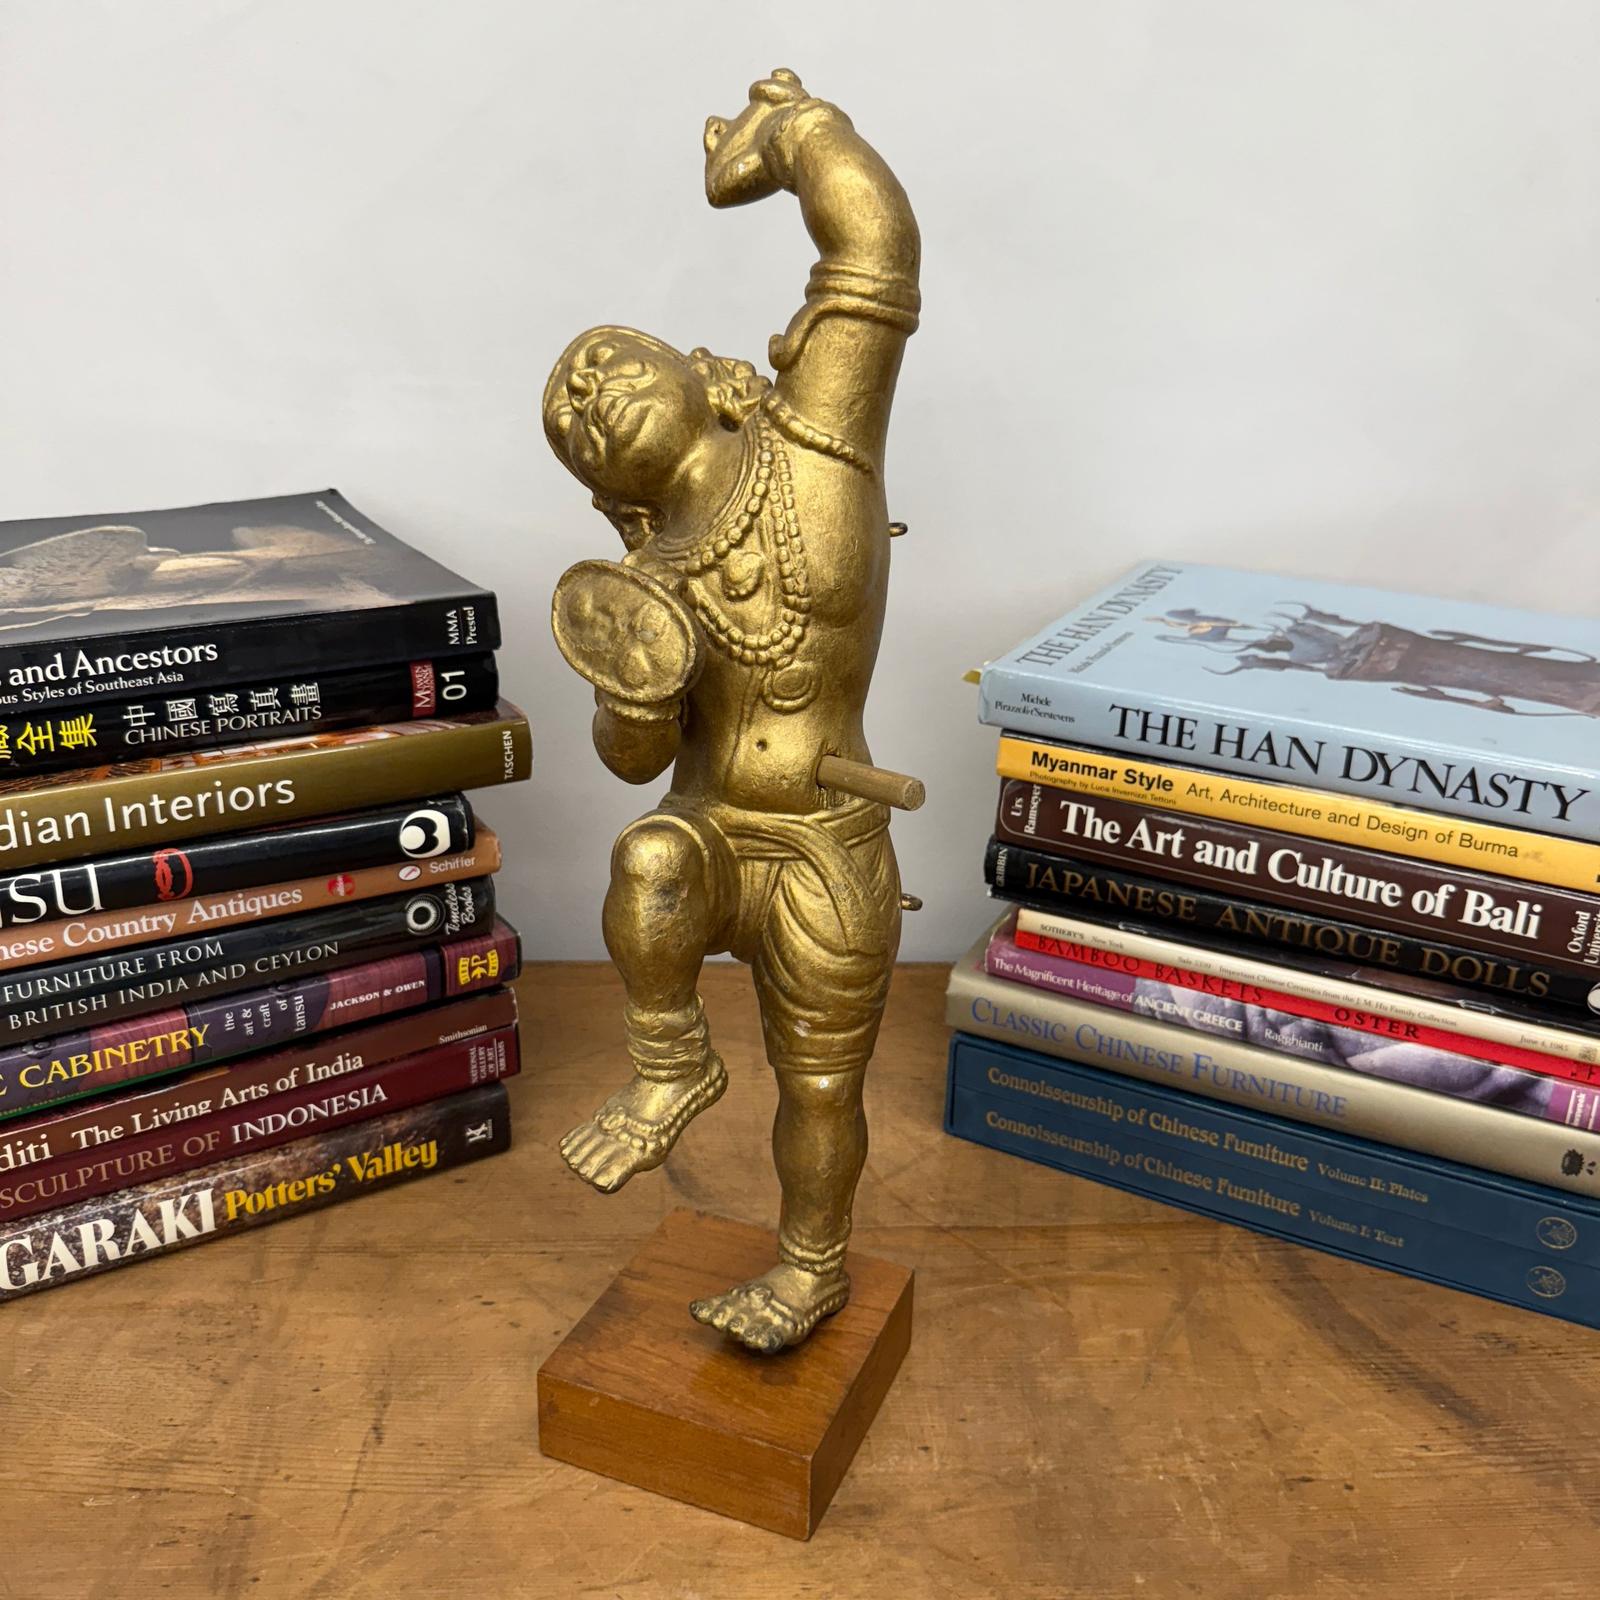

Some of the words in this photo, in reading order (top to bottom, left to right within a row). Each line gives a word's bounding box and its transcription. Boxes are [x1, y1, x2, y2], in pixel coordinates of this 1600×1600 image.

[446, 609, 460, 645] MMA
[462, 606, 478, 645] Prestel
[1015, 640, 1080, 666] THE
[1057, 611, 1116, 642] HAN
[1101, 564, 1183, 615] DYNASTY
[9, 652, 67, 686] and
[72, 643, 219, 679] Ancestors
[441, 670, 467, 701] 01
[22, 687, 65, 704] Styles
[68, 682, 82, 696] of
[85, 676, 154, 693] Southeast
[156, 671, 185, 685] Asia
[125, 720, 210, 745] CHINESE
[218, 705, 322, 732] PORTRAITS
[503, 730, 513, 780] TASCHEN
[1031, 751, 1118, 781] Myanmar
[1123, 768, 1175, 792] Style
[1108, 703, 1199, 751] THE
[1209, 722, 1328, 776] HAN
[1338, 745, 1591, 822] DYNASTY
[1030, 771, 1077, 790] Photography
[1079, 781, 1088, 791] by
[1090, 782, 1110, 795] Luca
[0, 809, 91, 851] dian
[104, 780, 296, 832] Interiors
[1010, 797, 1023, 816] Urs
[1023, 783, 1042, 835] Ramseyer
[1185, 782, 1214, 801] Art,
[1219, 788, 1321, 821] Architecture
[1327, 810, 1360, 828] and
[1366, 815, 1429, 842] Design
[1435, 830, 1454, 845] of
[1458, 833, 1518, 858] Burma
[429, 856, 476, 875] Schiffer
[1060, 800, 1120, 844] The
[1124, 818, 1187, 858] Art
[1193, 841, 1259, 875] and
[1267, 848, 1403, 907] Culture
[1411, 884, 1457, 919] of
[1457, 888, 1543, 940] Bali
[8, 863, 104, 923] SU
[445, 882, 460, 935] Timeless
[461, 886, 476, 924] Books
[63, 911, 177, 948] Country
[187, 887, 303, 925] Antiques
[1026, 862, 1198, 921] JAPANESE
[1215, 905, 1403, 966] ANTIQUE
[1420, 946, 1551, 998] DOLLS
[1566, 910, 1591, 953] Oxford
[3, 957, 147, 1003] FURNITURE
[157, 941, 225, 969] FROM
[9, 994, 108, 1030] BRITISH
[119, 977, 190, 1004] INDIA
[197, 963, 247, 987] AND
[255, 941, 340, 974] CEYLON
[1037, 936, 1141, 973] BAMBOO
[1154, 962, 1264, 1001] BASKETS
[241, 1008, 252, 1019] &
[260, 1003, 271, 1028] craft
[276, 999, 288, 1011] of
[294, 995, 306, 1032] tansu
[330, 991, 380, 1011] JACKSON
[383, 987, 393, 997] &
[395, 980, 425, 994] OWEN
[994, 957, 1014, 973] The
[1014, 962, 1075, 990] Magnificent
[1077, 978, 1122, 1002] Heritage
[1122, 990, 1136, 1003] of
[1134, 993, 1191, 1019] ANCIENT
[1192, 1007, 1243, 1033] GREECE
[225, 1012, 235, 1031] the
[243, 1020, 254, 1036] art
[439, 1024, 488, 1044] Smithsonian
[1264, 1028, 1324, 1052] Ragghianti
[1334, 1007, 1419, 1040] OSTER
[19, 1024, 210, 1089] CABINETRY
[971, 997, 1066, 1042] CLASSIC
[1075, 1023, 1184, 1073] CHINESE
[1192, 1052, 1348, 1117] FURNITURE
[71, 1125, 124, 1150] The
[131, 1100, 213, 1133] Living
[219, 1082, 270, 1110] Arts
[275, 1067, 300, 1092] of
[305, 1052, 364, 1084] India
[988, 1067, 1124, 1121] Connoisseurship
[1127, 1104, 1147, 1126] of
[1148, 1111, 1219, 1148] Chinese
[1223, 1132, 1309, 1172] Furniture
[0, 1144, 175, 1209] SCULPTURE
[183, 1131, 221, 1156] OF
[231, 1083, 388, 1145] INDONESIA
[347, 1140, 438, 1182] Valley
[986, 1110, 1121, 1166] Connoisseurship
[1124, 1151, 1142, 1170] of
[1142, 1156, 1213, 1191] Chinese
[1216, 1176, 1302, 1217] Furniture
[1317, 1162, 1366, 1188] Volume
[1388, 1181, 1429, 1203] Plates
[0, 1188, 217, 1291] GARAKI
[1308, 1208, 1357, 1234] Volume
[1373, 1230, 1404, 1248] Text
